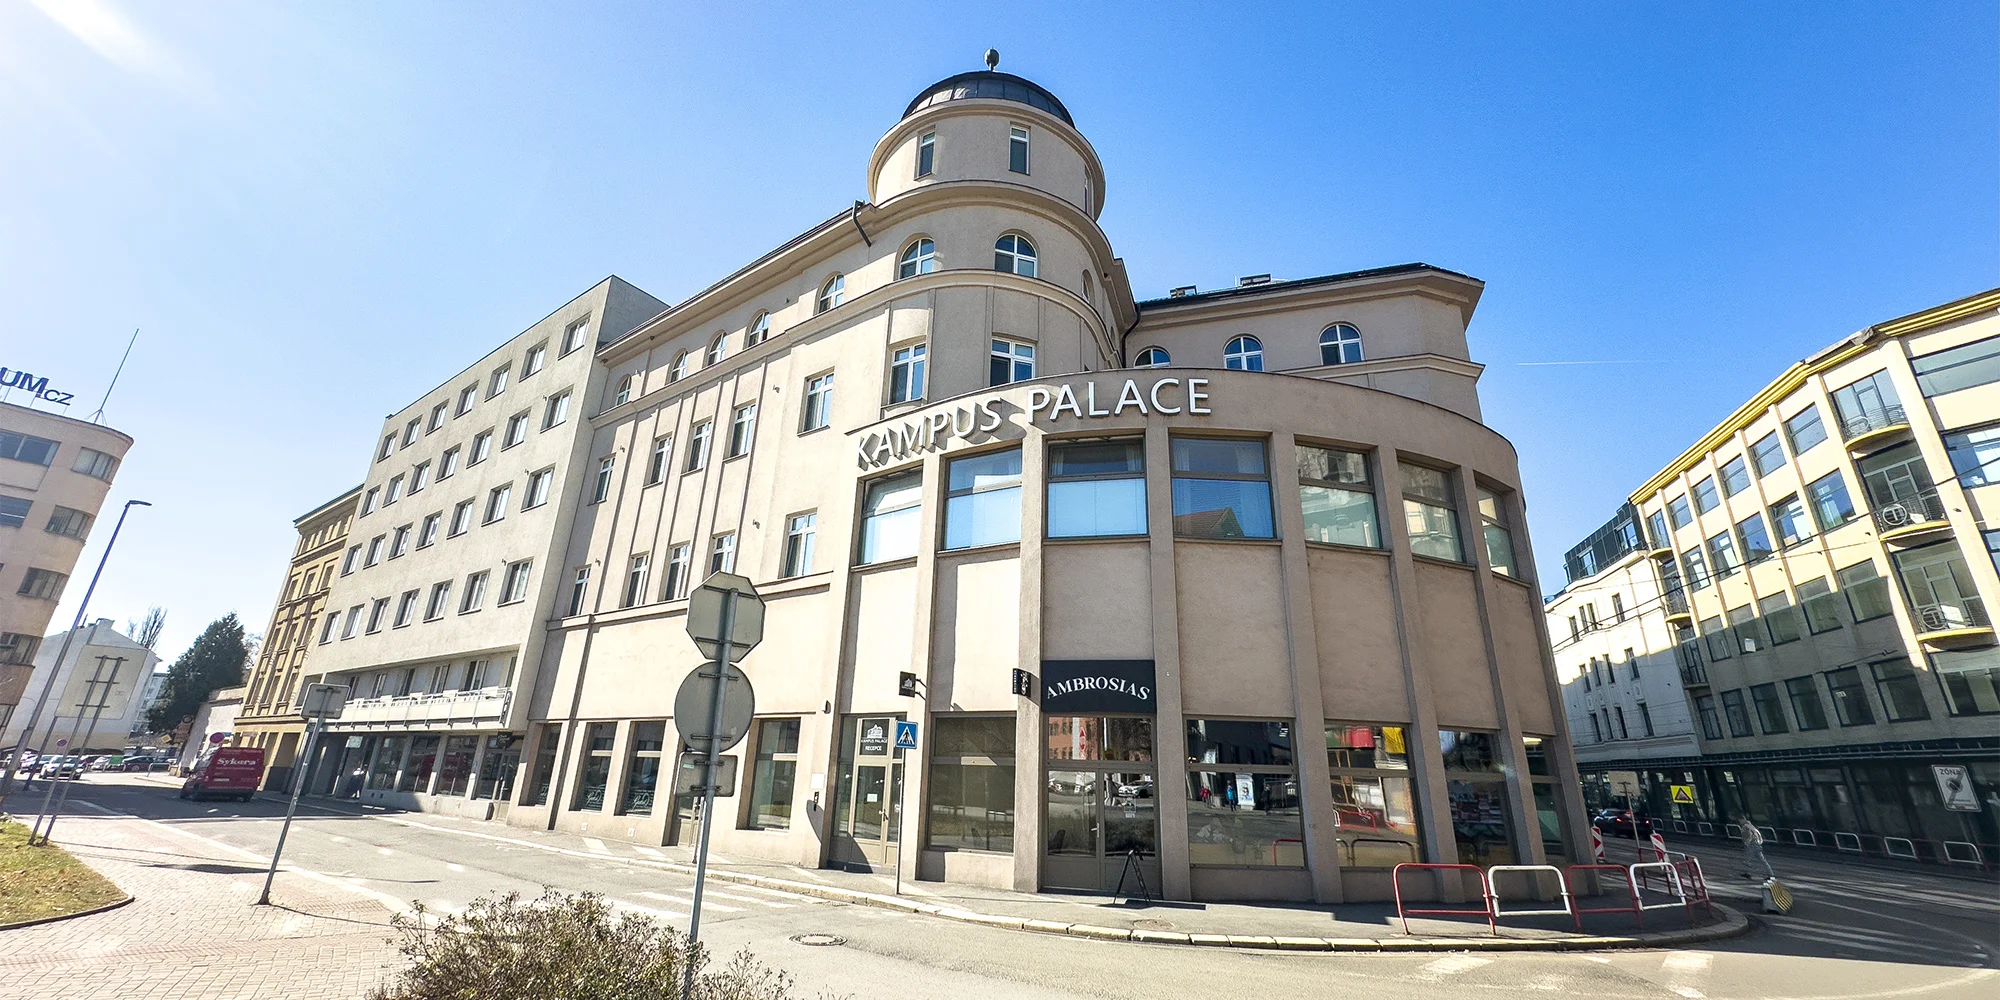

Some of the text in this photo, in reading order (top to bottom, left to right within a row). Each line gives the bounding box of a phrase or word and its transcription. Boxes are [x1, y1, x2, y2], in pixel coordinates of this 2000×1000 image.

[856, 378, 1212, 464] KAMPUS PALACE
[1047, 676, 1151, 700] AMBROSIAS
